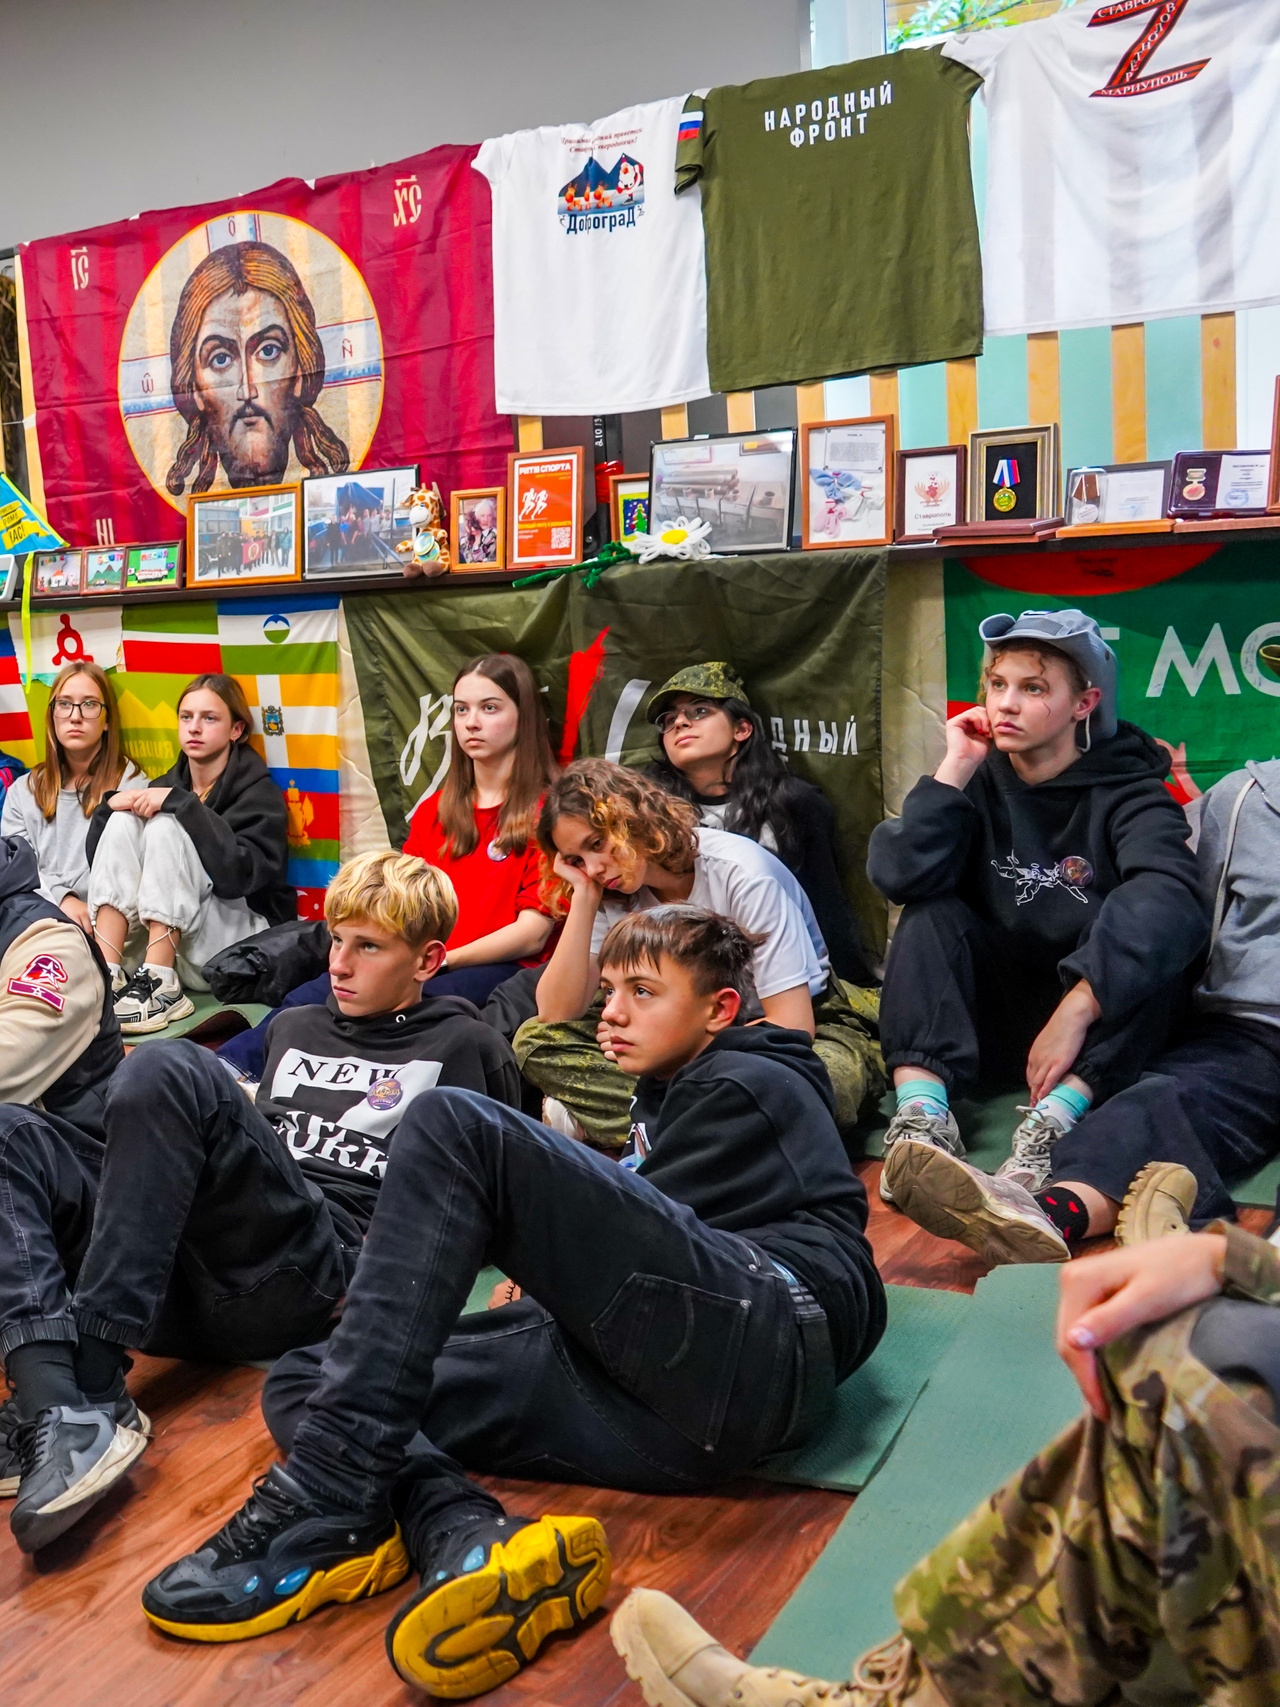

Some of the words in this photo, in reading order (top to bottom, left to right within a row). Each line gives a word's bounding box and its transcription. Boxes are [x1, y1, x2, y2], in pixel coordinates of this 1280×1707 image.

[1098, 0, 1157, 18] СТАВРО
[1101, 71, 1187, 95] МАРИУПОЛЬ
[764, 80, 892, 131] НАРОДНЫЙ
[790, 112, 867, 148] ФРОНТ
[520, 465, 540, 475] РИТМ
[541, 463, 571, 472] СПОРТА
